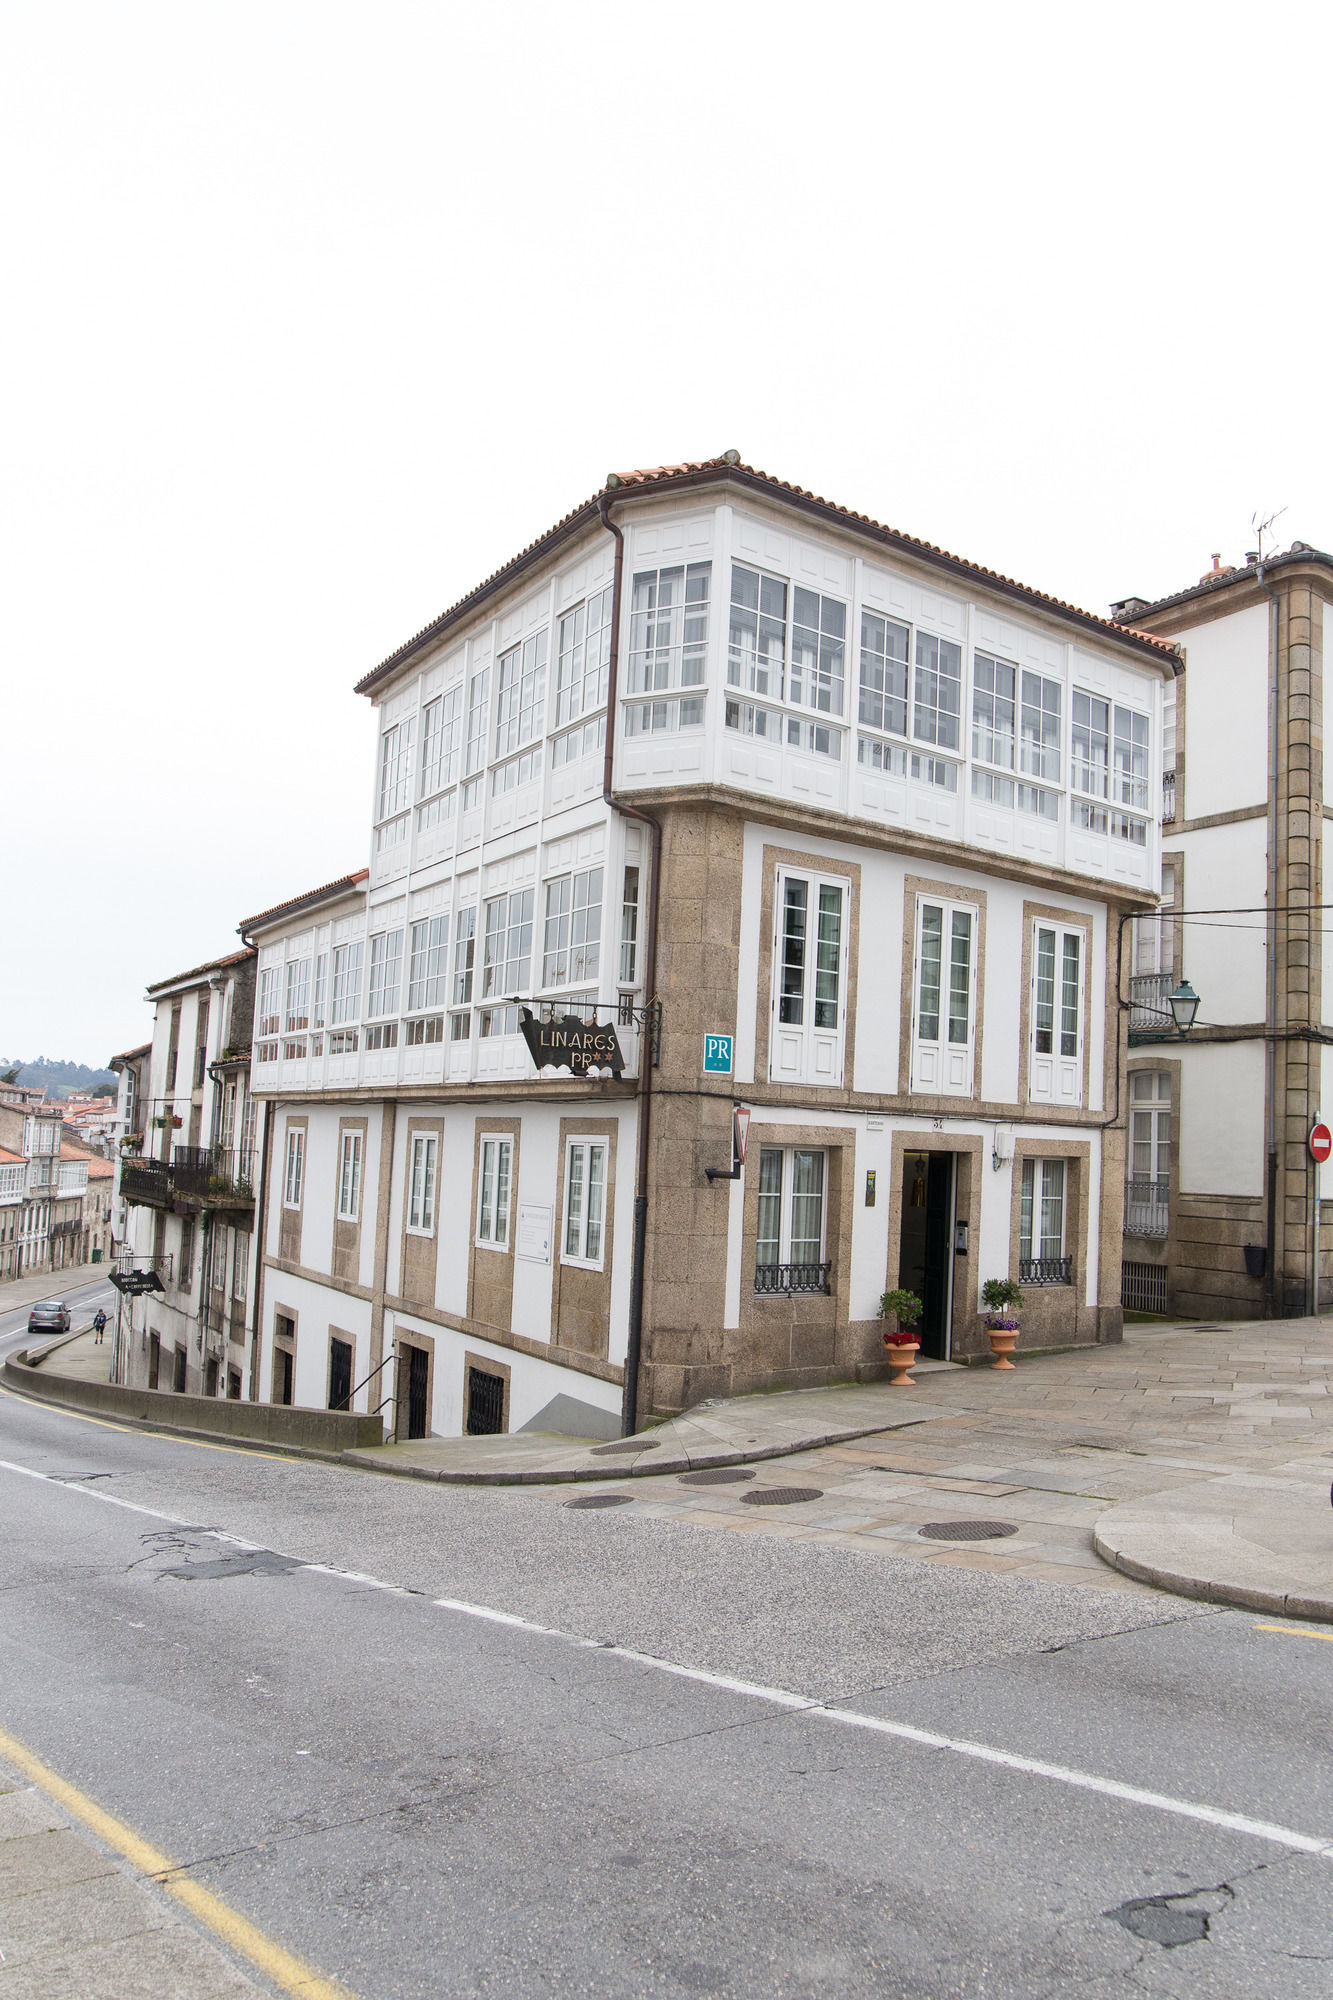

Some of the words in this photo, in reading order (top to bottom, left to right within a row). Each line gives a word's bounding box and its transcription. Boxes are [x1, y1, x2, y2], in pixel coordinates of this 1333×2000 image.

[540, 1030, 615, 1051] LINARES
[708, 1039, 729, 1059] PR
[571, 1052, 592, 1069] PR
